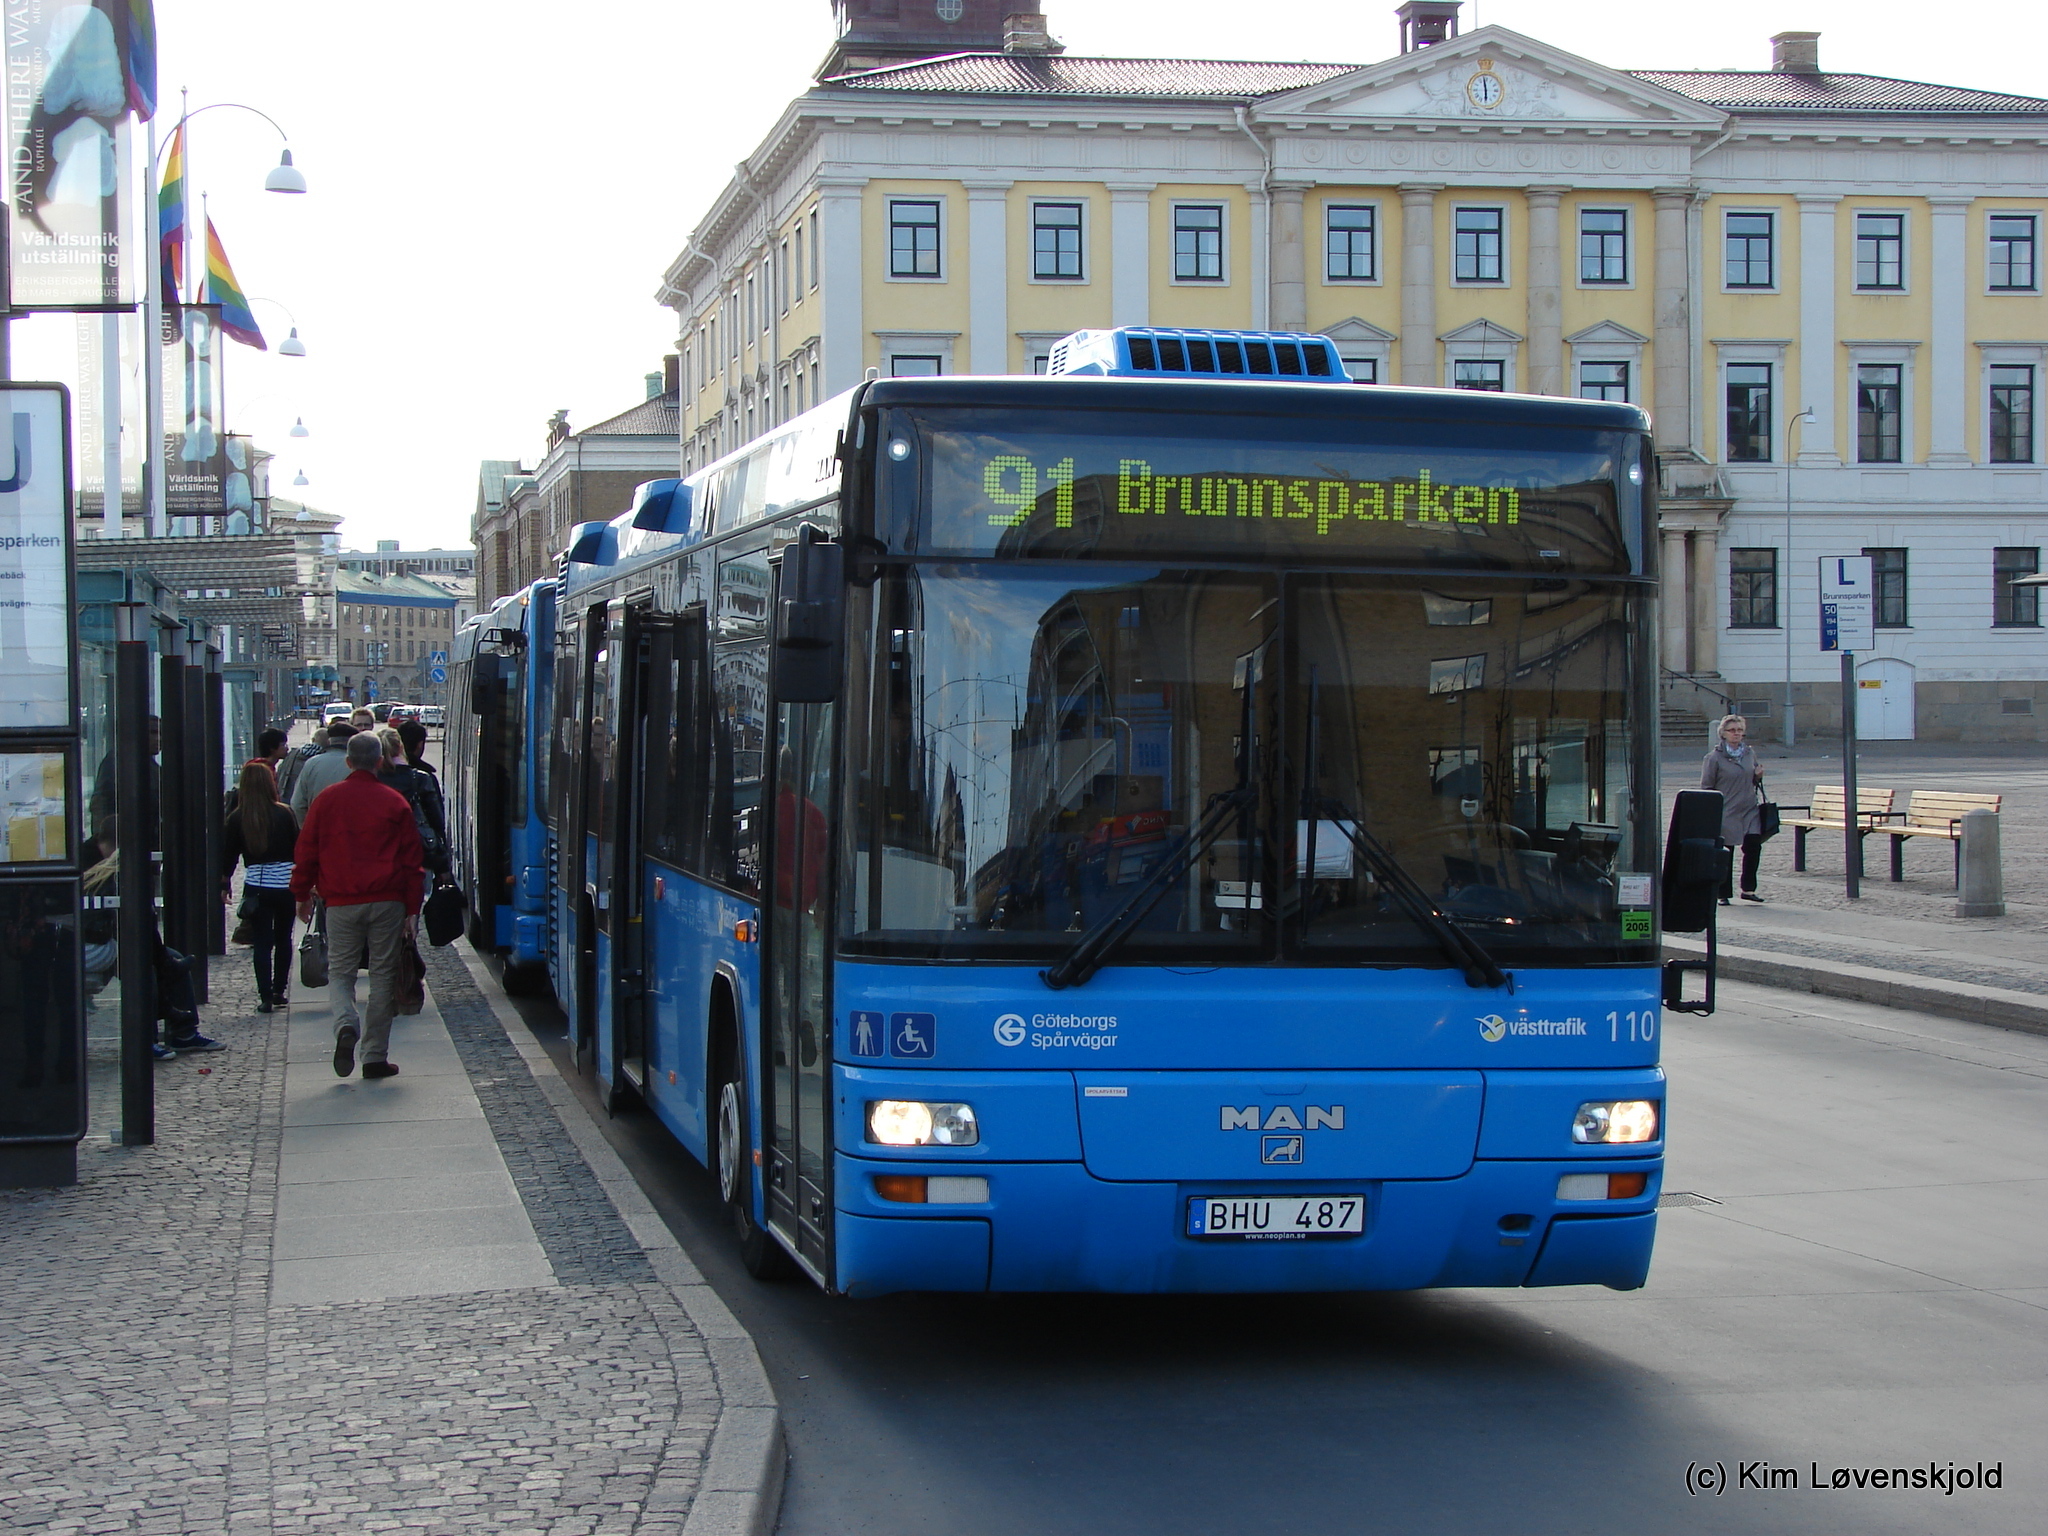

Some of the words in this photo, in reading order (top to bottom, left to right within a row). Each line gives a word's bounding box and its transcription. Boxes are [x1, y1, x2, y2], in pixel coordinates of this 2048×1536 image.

[33, 46, 43, 105] LEONARDO
[10, 55, 32, 139] THERE
[35, 127, 45, 172] RAPHAEL
[21, 232, 119, 247] Världsunik
[21, 250, 120, 267] utställning
[16, 276, 126, 286] ERIKSBERGSHALLEN
[30, 289, 59, 298] MARS
[82, 288, 127, 298] AUGUSTI
[78, 355, 91, 385] WAS
[79, 387, 92, 430] THERE
[168, 474, 219, 483] Världsunik
[169, 483, 219, 493] utställning
[982, 455, 1075, 528] 91
[1117, 458, 1520, 535] Brunnsparken
[1838, 558, 1855, 585] L
[1822, 592, 1871, 601] Brunnsparken
[1824, 605, 1837, 615] 50
[1625, 922, 1650, 932] 2005
[1031, 1013, 1118, 1031] Göteborgs
[1508, 1018, 1587, 1036] västtrafik
[1606, 1010, 1654, 1042] 110
[1031, 1031, 1118, 1050] Spårvägar
[1221, 1106, 1344, 1130] MAN
[1210, 1202, 1270, 1230] BHU
[1295, 1201, 1356, 1229] 487
[1244, 1232, 1306, 1240] www.neoplan.se
